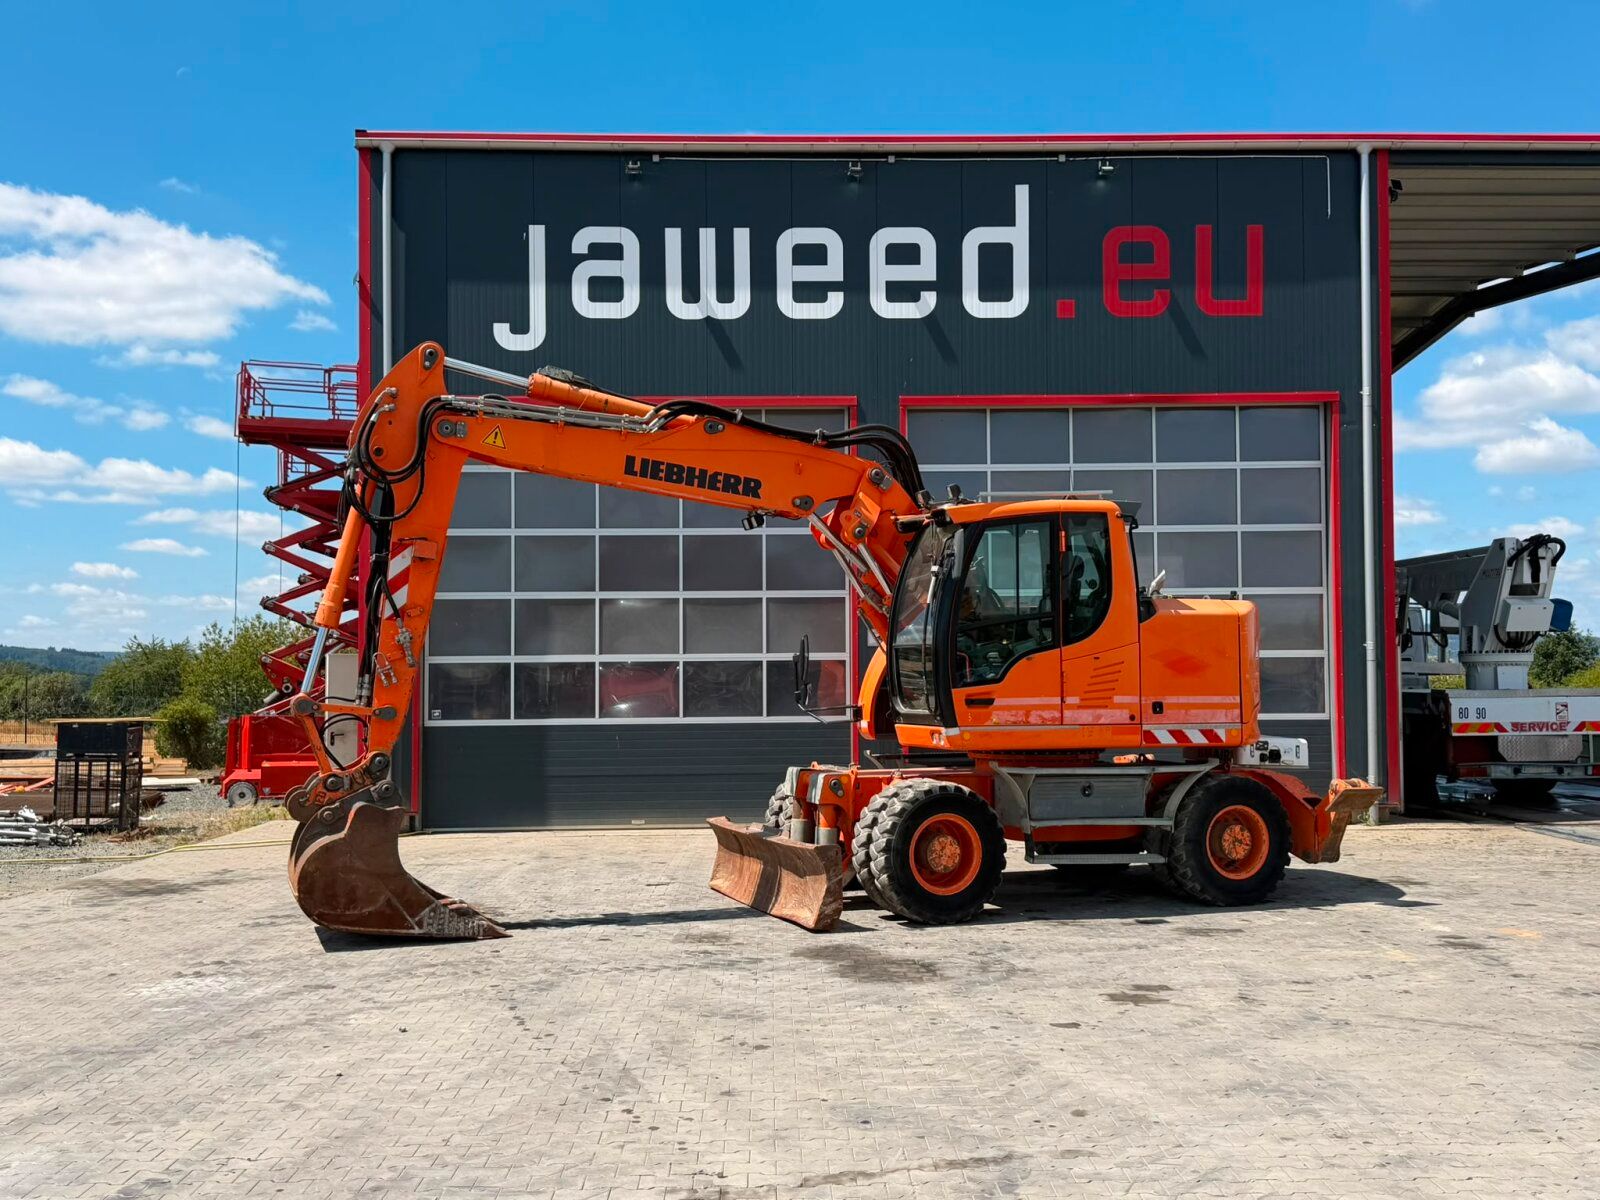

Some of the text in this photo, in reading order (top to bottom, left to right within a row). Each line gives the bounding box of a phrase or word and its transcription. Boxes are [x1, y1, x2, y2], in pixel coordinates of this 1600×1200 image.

[624, 455, 762, 499] LIEBHERR
[1458, 706, 1487, 720] 80 90
[1511, 721, 1568, 732] SERVICE
